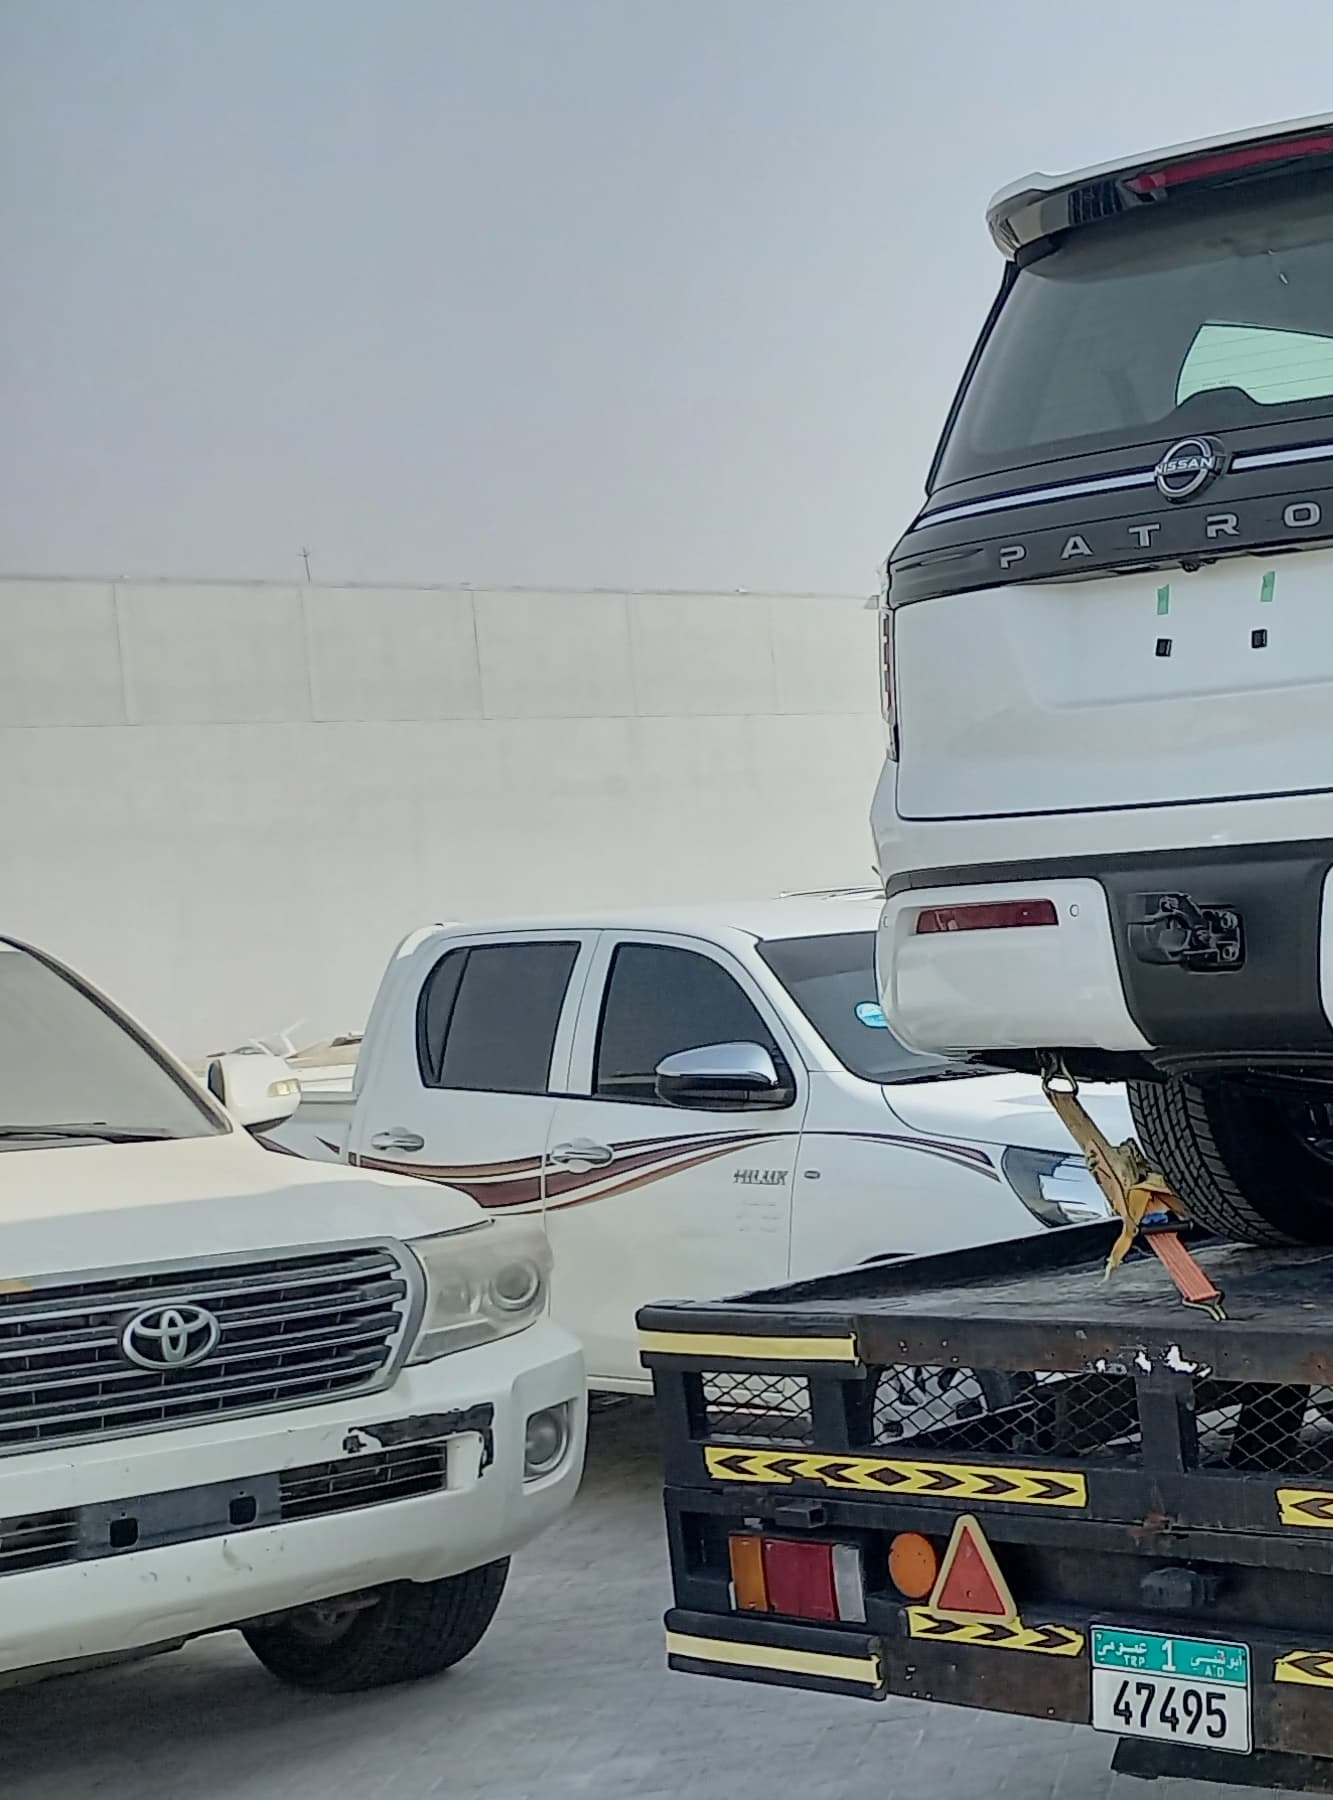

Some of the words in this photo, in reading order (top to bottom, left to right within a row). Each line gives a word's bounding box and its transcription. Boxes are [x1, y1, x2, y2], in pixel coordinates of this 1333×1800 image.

[1154, 455, 1214, 477] NISSAN
[1161, 1639, 1177, 1672] 1
[1113, 1679, 1227, 1739] 47495
